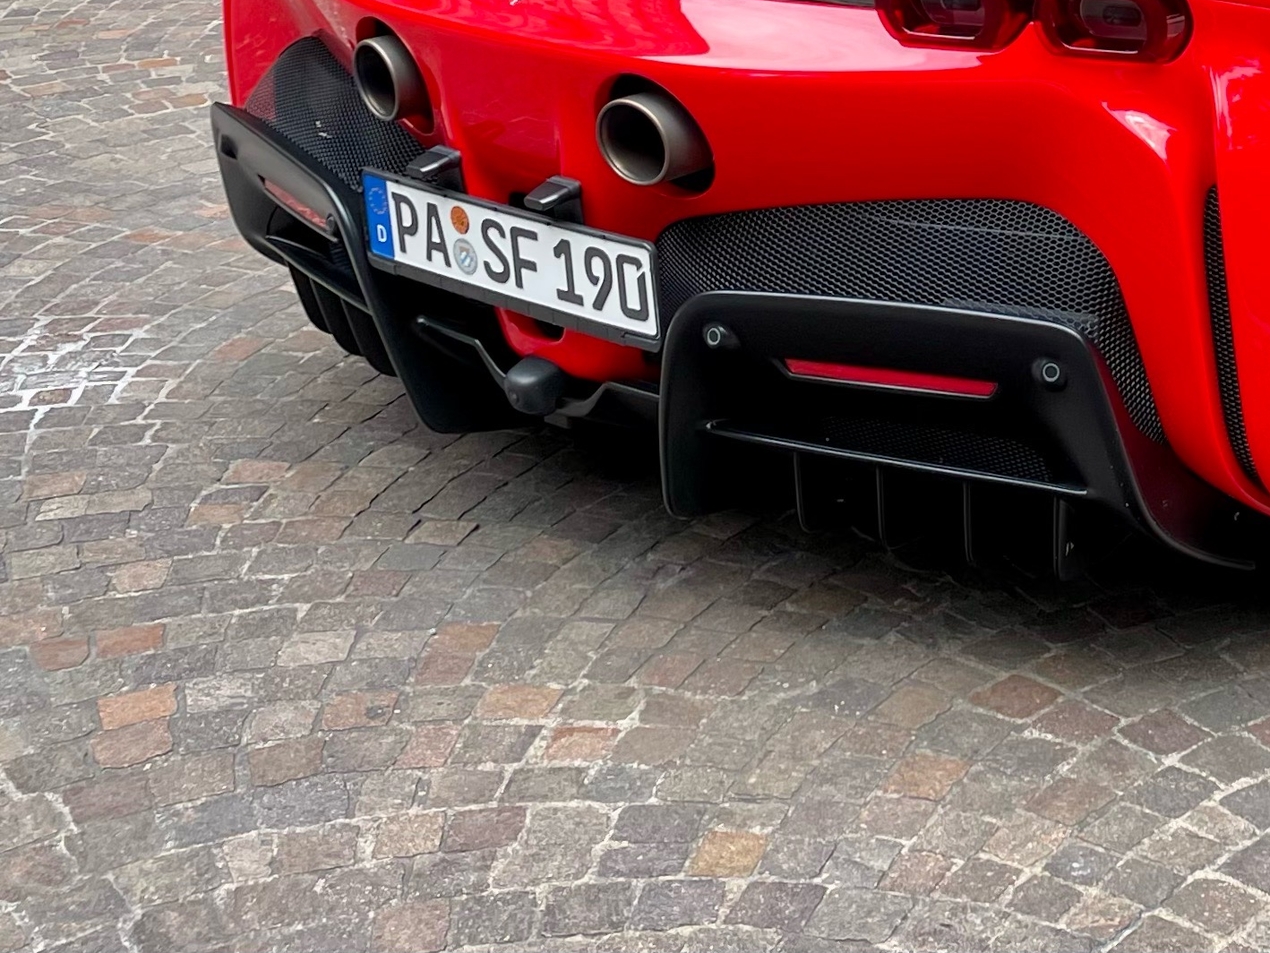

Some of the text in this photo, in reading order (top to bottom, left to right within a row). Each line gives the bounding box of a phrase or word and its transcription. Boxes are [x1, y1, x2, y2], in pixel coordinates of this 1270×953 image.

[376, 223, 387, 243] D
[391, 191, 649, 322] PA SF 190
